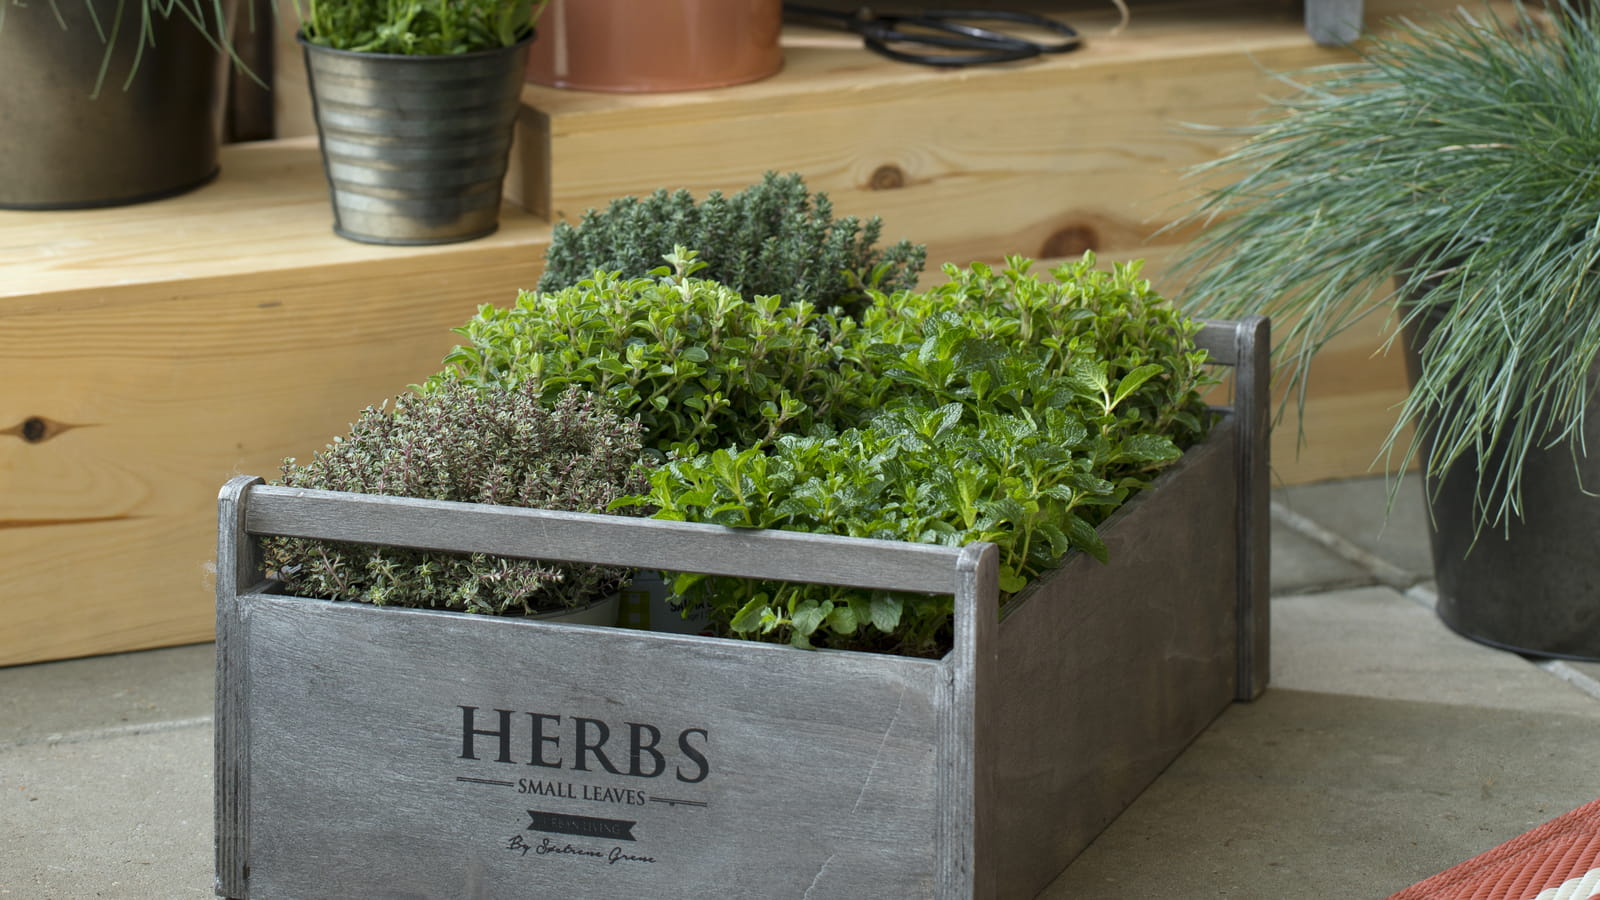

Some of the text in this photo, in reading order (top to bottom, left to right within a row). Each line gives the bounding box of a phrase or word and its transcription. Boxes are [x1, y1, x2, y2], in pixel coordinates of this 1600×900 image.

[457, 705, 709, 784] HERBS
[518, 778, 646, 806] SMALL LEAVES
[506, 834, 531, 856] By
[608, 846, 657, 865] Grene
